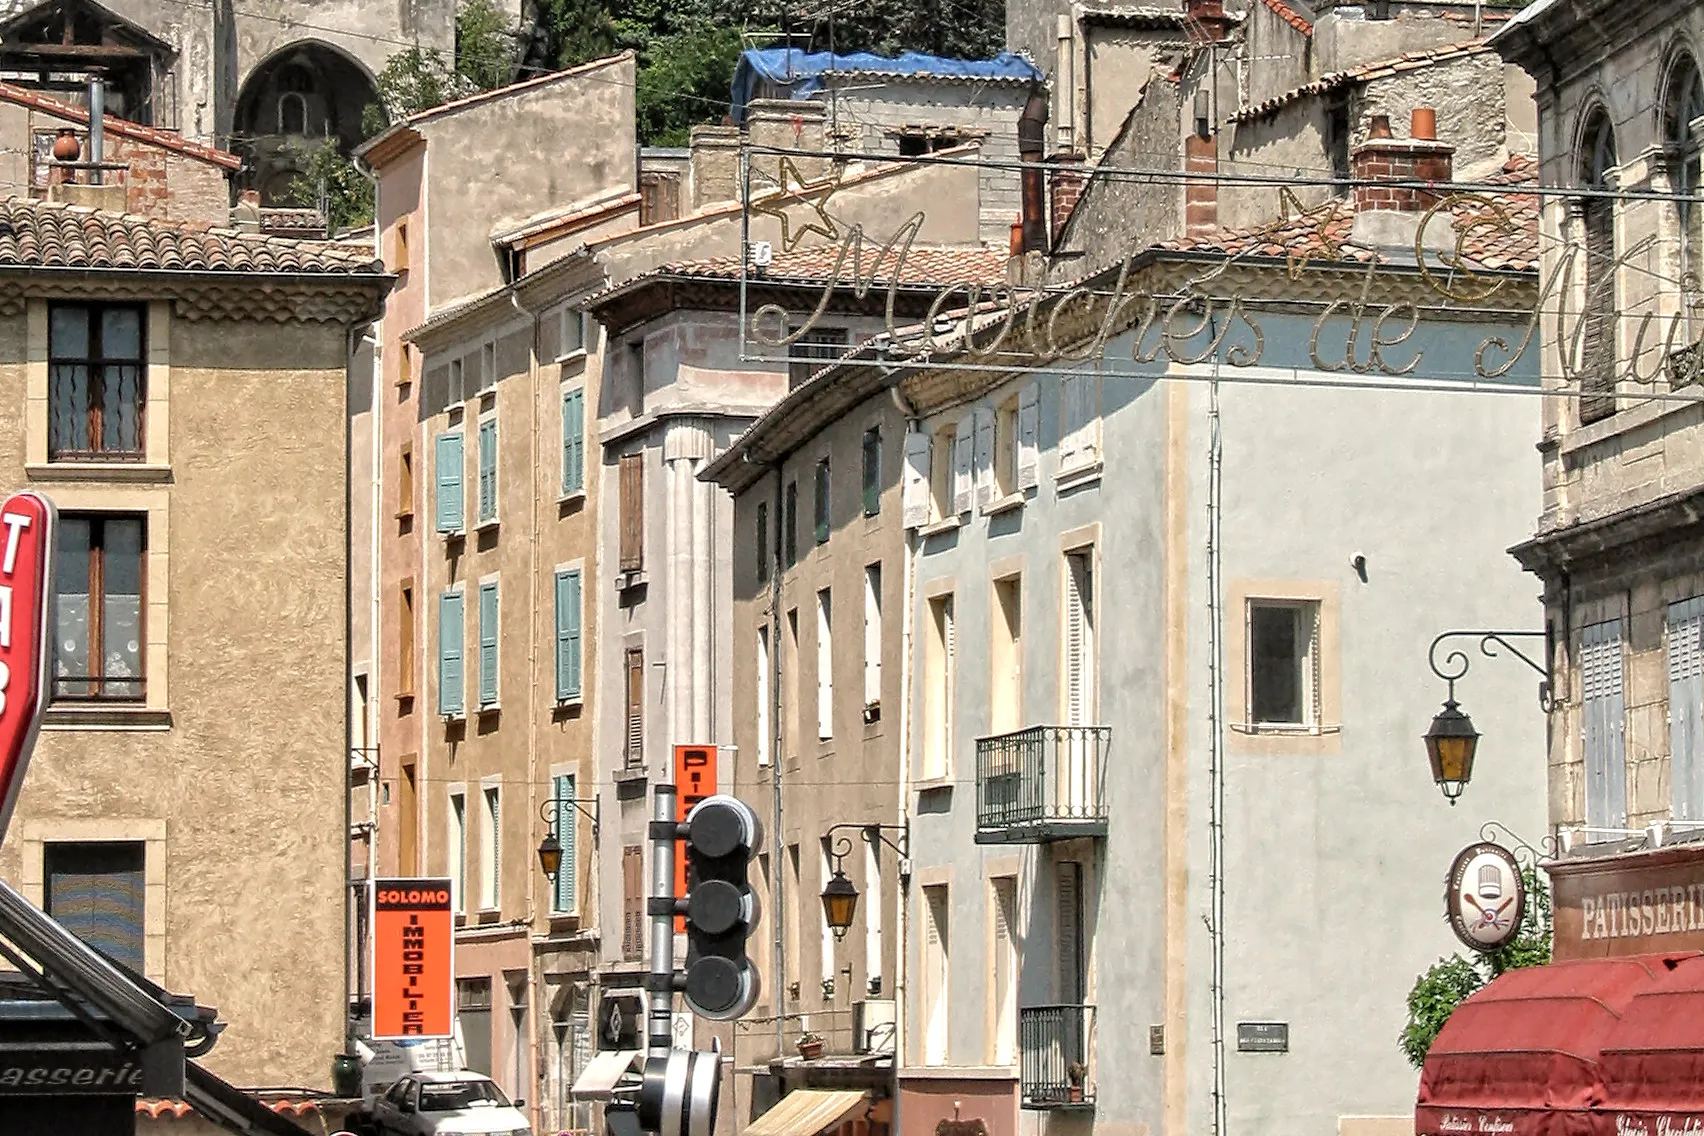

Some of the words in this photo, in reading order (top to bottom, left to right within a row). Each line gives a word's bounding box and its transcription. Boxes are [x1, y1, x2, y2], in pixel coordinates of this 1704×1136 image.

[1309, 242, 1424, 375] de
[377, 890, 449, 905] SOLOMO
[402, 914, 425, 1036] IMMOBILIER
